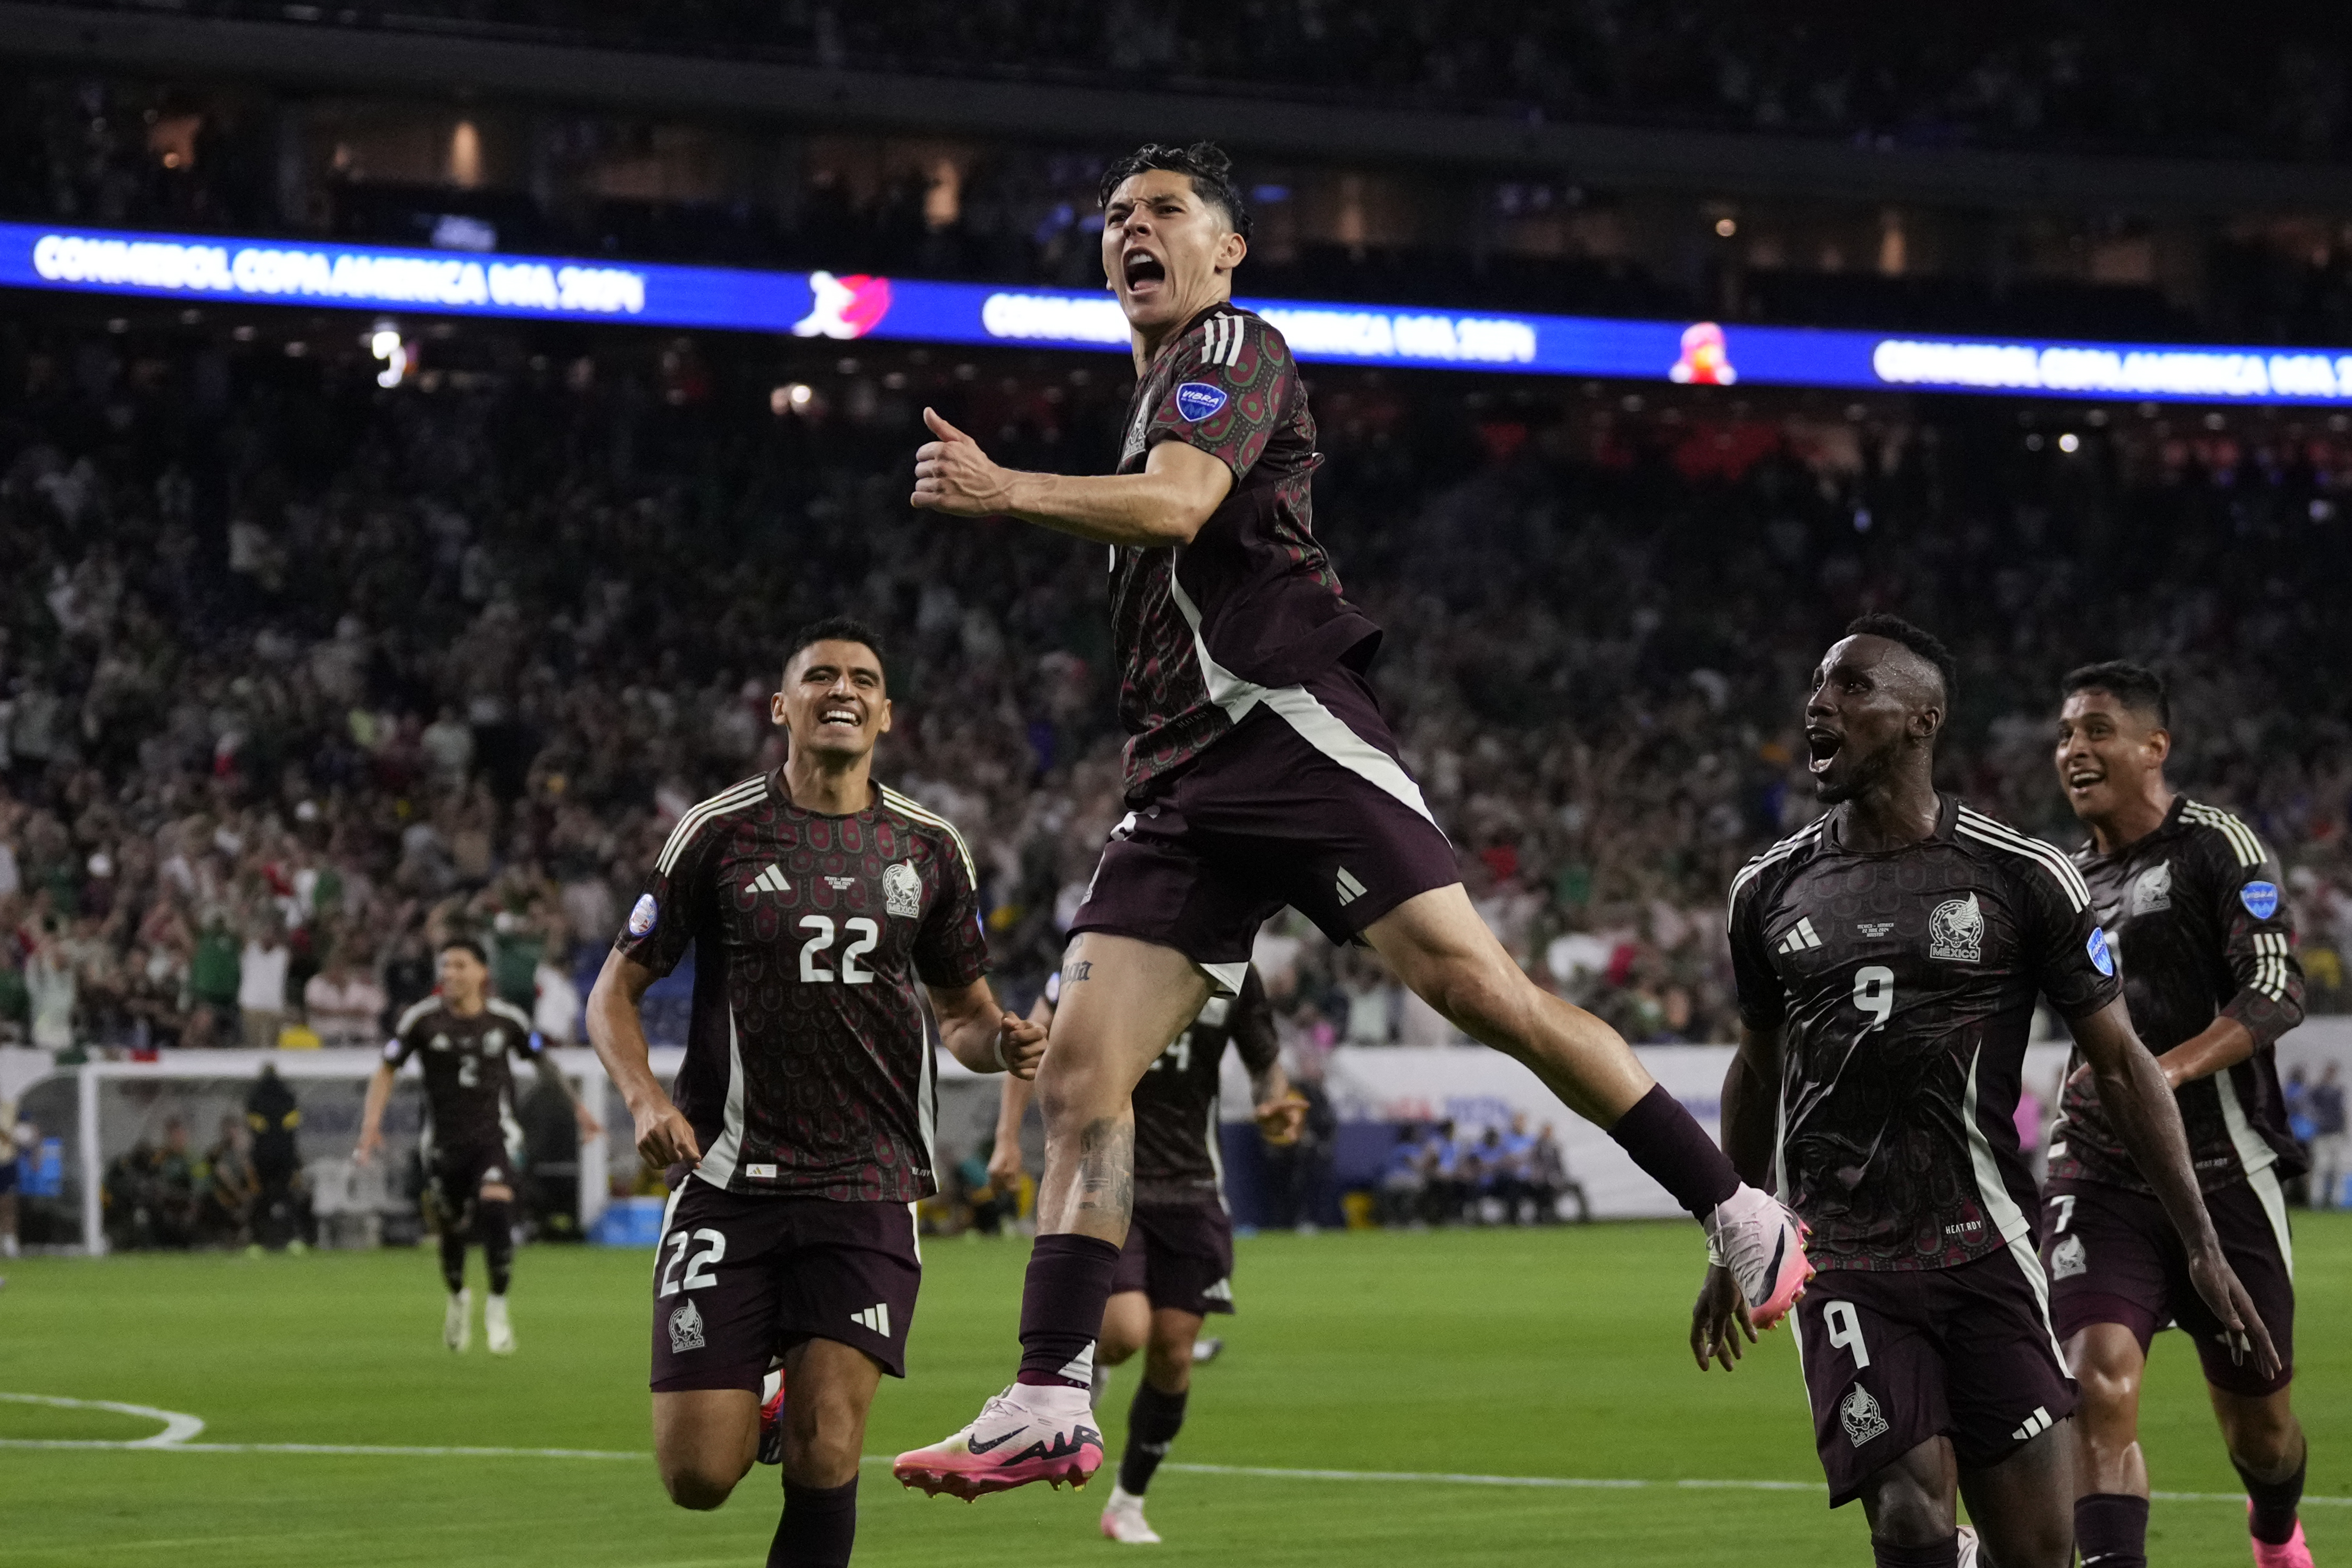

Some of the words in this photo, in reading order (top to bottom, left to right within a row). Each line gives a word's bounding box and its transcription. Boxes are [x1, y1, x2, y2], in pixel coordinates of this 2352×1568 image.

[1182, 390, 1219, 405] VIBRA
[799, 915, 878, 983] 22
[1853, 966, 1894, 1031] 9
[458, 1055, 479, 1087] 2
[1945, 1220, 1981, 1235] HEAT.RDY
[2049, 1195, 2075, 1233] 7
[660, 1228, 725, 1298] 22
[1823, 1301, 1870, 1369] 9
